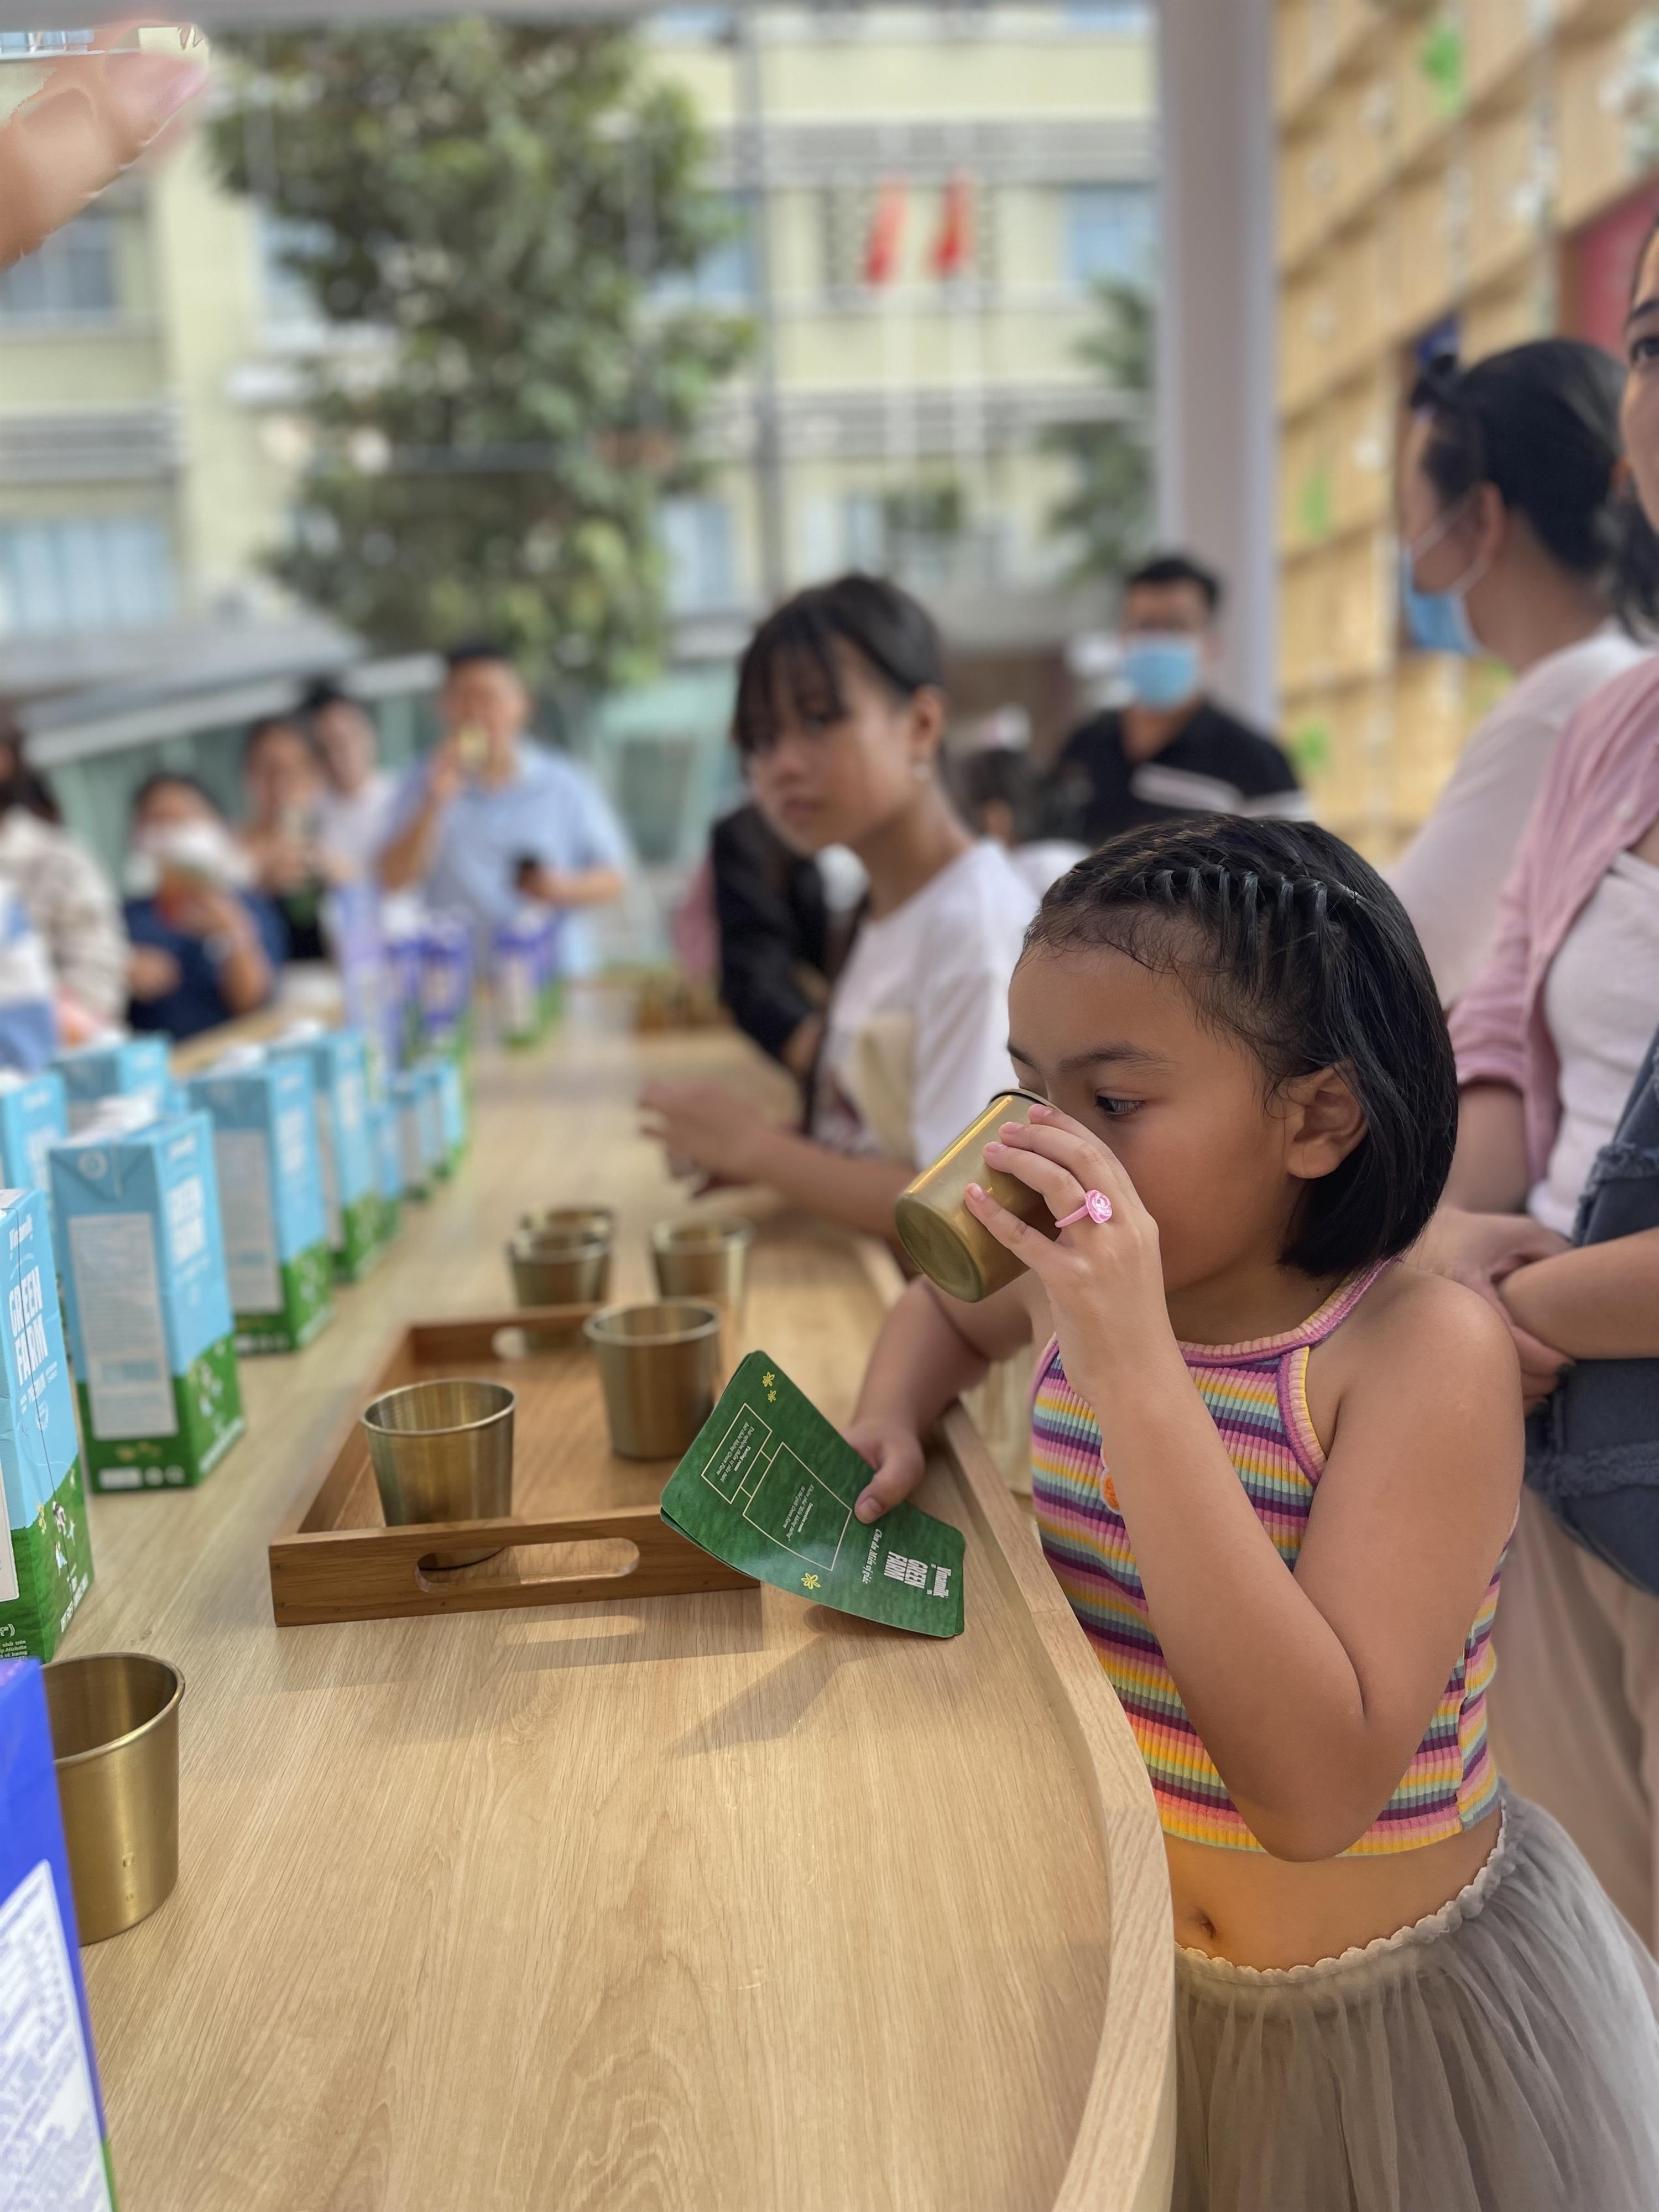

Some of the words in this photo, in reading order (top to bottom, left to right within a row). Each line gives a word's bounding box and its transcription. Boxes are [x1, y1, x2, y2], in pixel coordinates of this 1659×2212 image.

[9, 1265, 43, 1337] GREEN
[15, 1313, 48, 1386] FARM
[723, 1451, 732, 1464] Green
[739, 1446, 751, 1460] Tasting
[716, 1462, 725, 1475] Farm
[802, 1503, 813, 1522] Immersive
[873, 1528, 882, 1542] Chu
[871, 1541, 879, 1550] du
[863, 1564, 873, 1573] vị
[884, 1551, 907, 1582] FARM
[904, 1559, 928, 1589] GREEN
[862, 1569, 872, 1584] giác
[933, 1566, 952, 1598] Vinamilk
